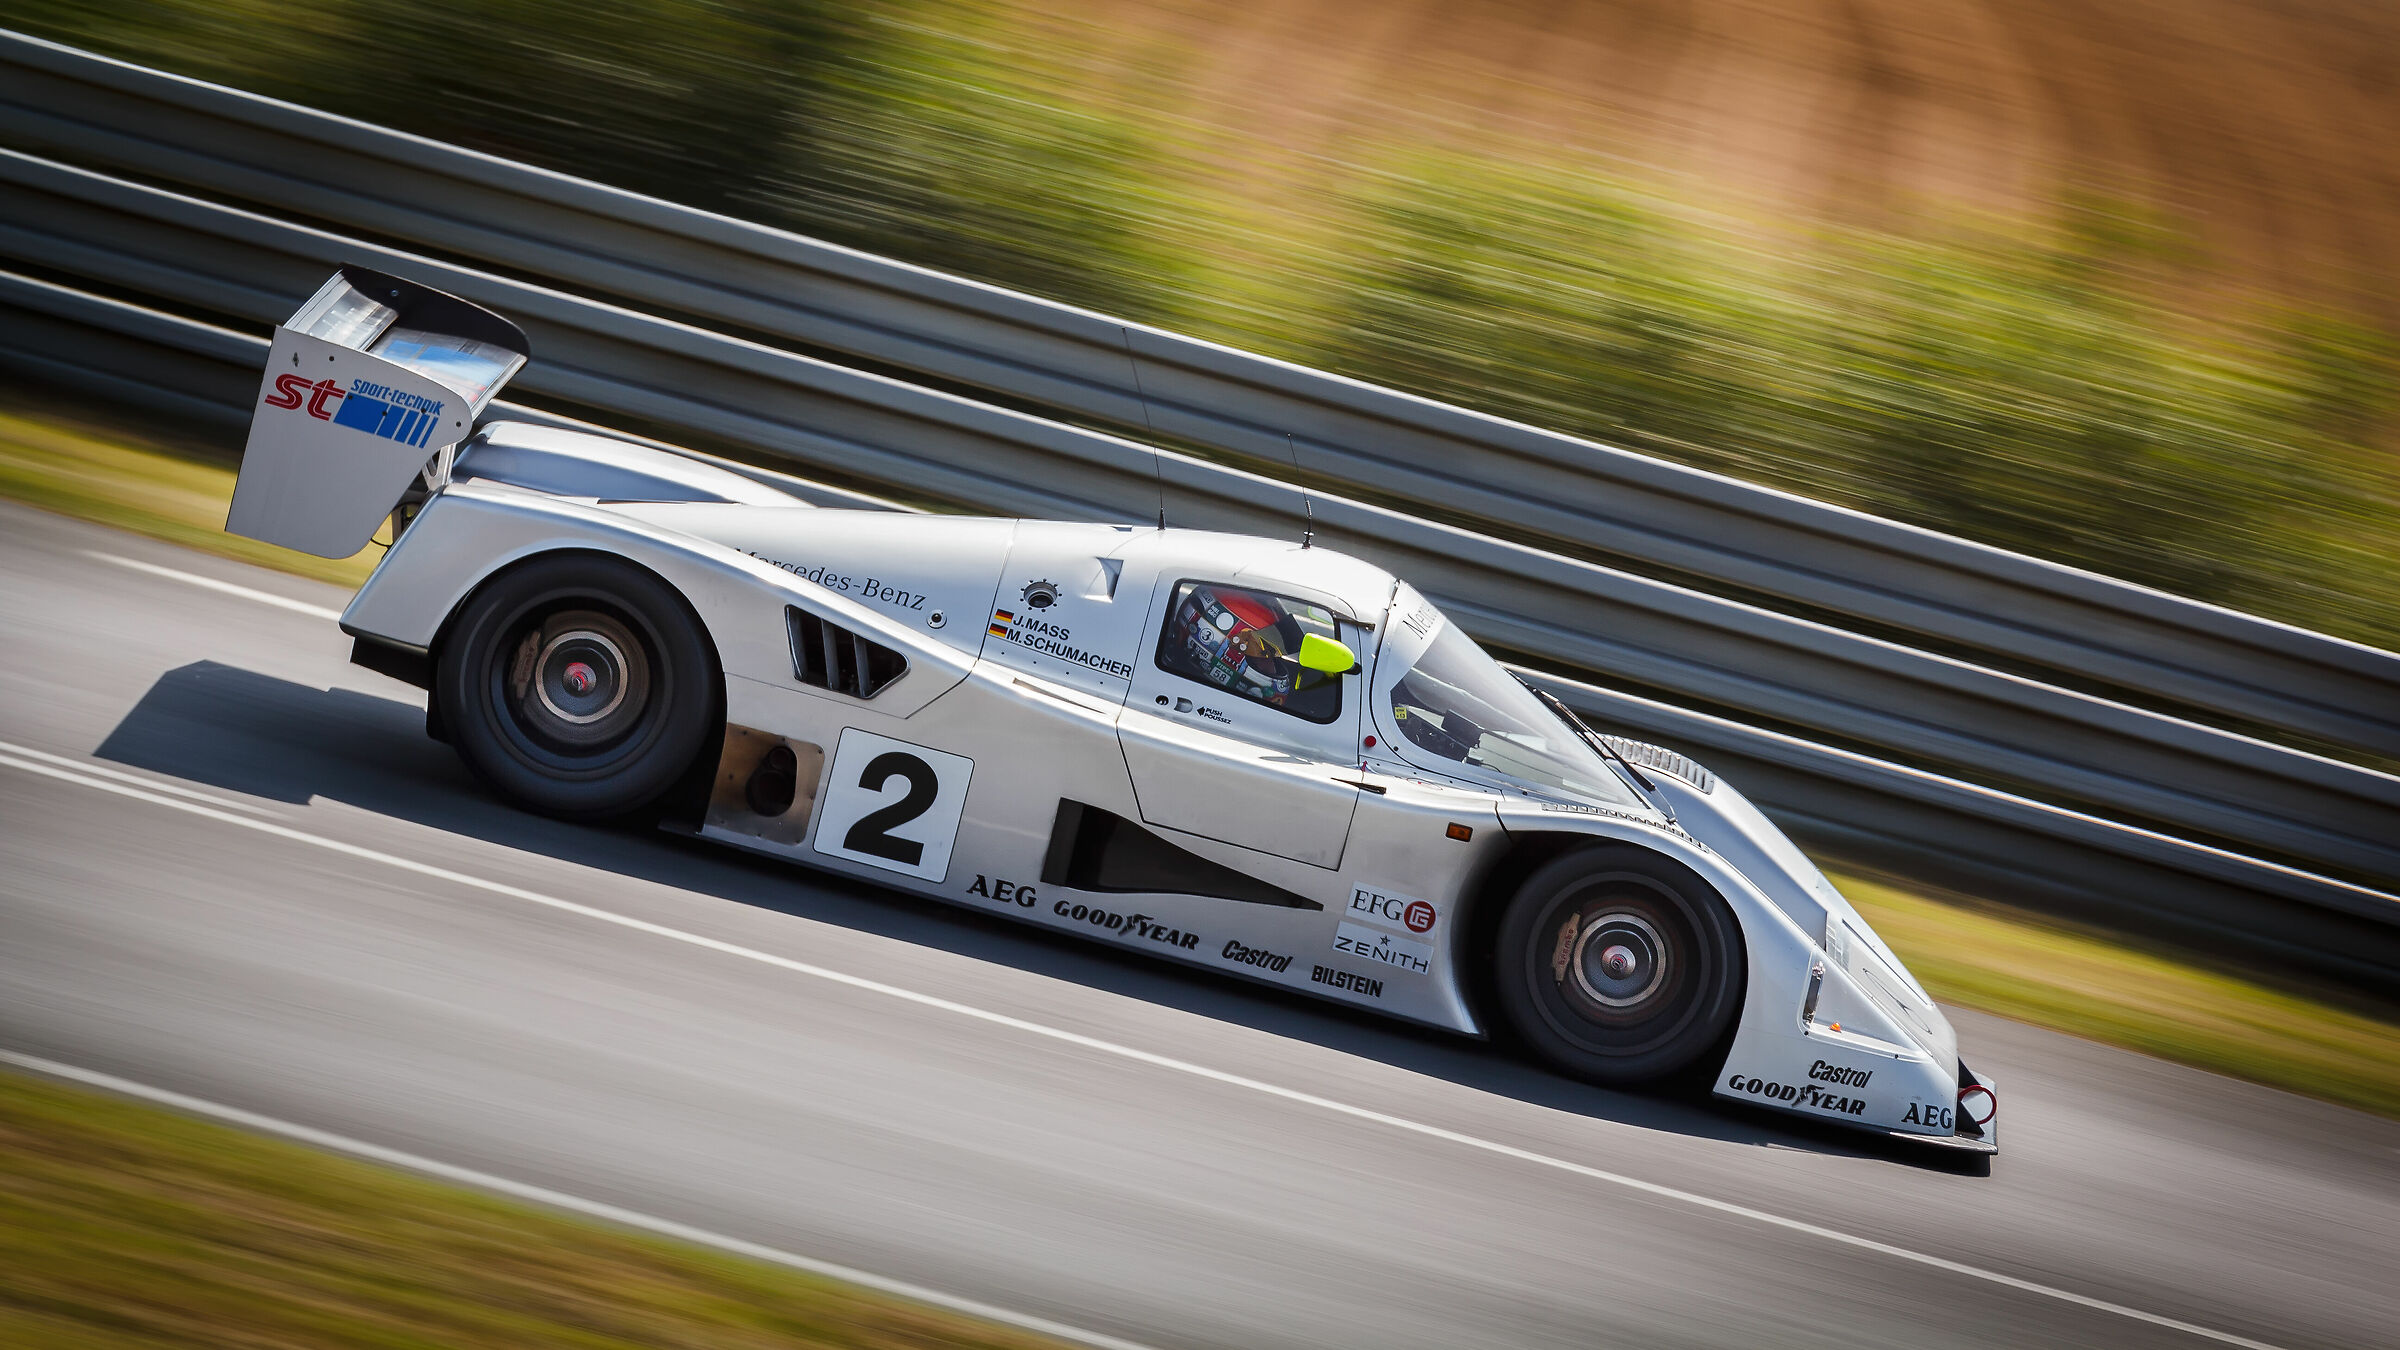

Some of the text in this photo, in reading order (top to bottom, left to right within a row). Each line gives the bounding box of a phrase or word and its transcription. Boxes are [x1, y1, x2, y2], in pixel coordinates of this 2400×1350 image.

[264, 373, 346, 421] st
[1012, 616, 1070, 641] J.MASS
[1006, 629, 1132, 678] M.SCHUMACHER
[1213, 670, 1227, 682] 58
[1203, 712, 1232, 725] POUSSEZ
[1205, 707, 1223, 717] PUSH
[843, 752, 939, 867] 2
[966, 874, 1037, 908] AEG
[1350, 888, 1404, 921] EFG
[1221, 940, 1294, 974] Castrol
[1335, 936, 1429, 973] ZENITH
[1311, 965, 1384, 998] BILSTEIN
[1808, 1059, 1873, 1088] Castrol
[1901, 1102, 1953, 1129] AEG
